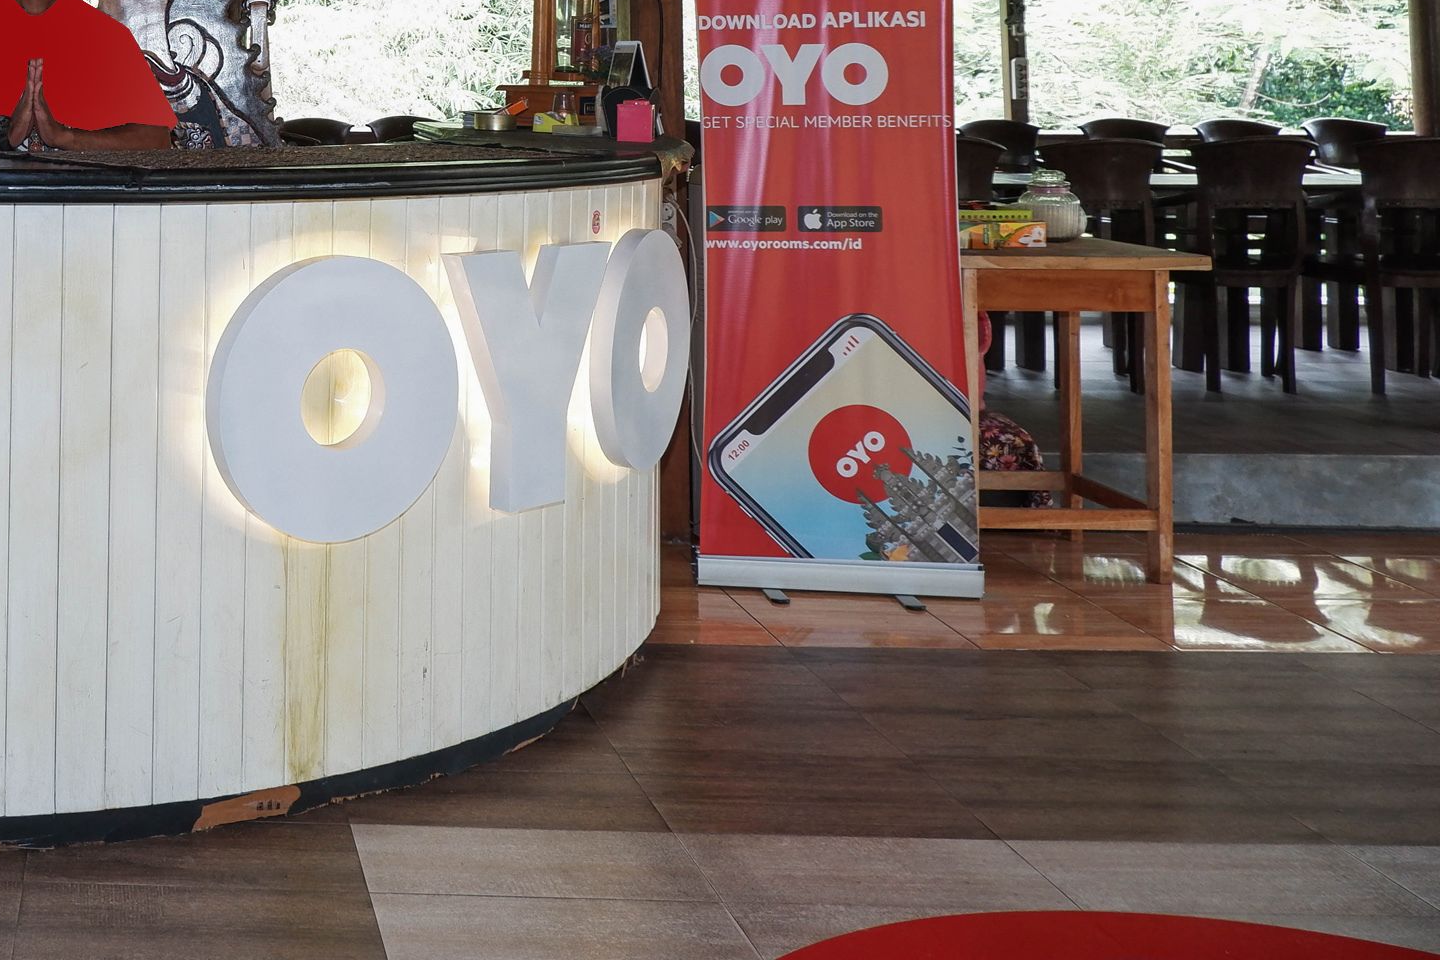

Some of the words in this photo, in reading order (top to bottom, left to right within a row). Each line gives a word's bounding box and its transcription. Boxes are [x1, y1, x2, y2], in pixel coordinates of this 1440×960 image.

[698, 13, 817, 31] DOWNLOAD
[822, 10, 926, 29] APLIKASI
[700, 42, 889, 107] OYO
[702, 116, 731, 129] GET
[735, 115, 800, 129] SPECIAL
[804, 115, 873, 128] MEMBER
[877, 114, 952, 128] BENEFITS
[728, 215, 762, 227] Google
[765, 216, 783, 226] play
[826, 218, 848, 229] App
[850, 218, 875, 228] Store
[704, 238, 862, 251] www.oyorooms.com/id
[206, 228, 691, 545] OYO
[727, 439, 751, 462] 12:00
[836, 431, 886, 478] OYO
